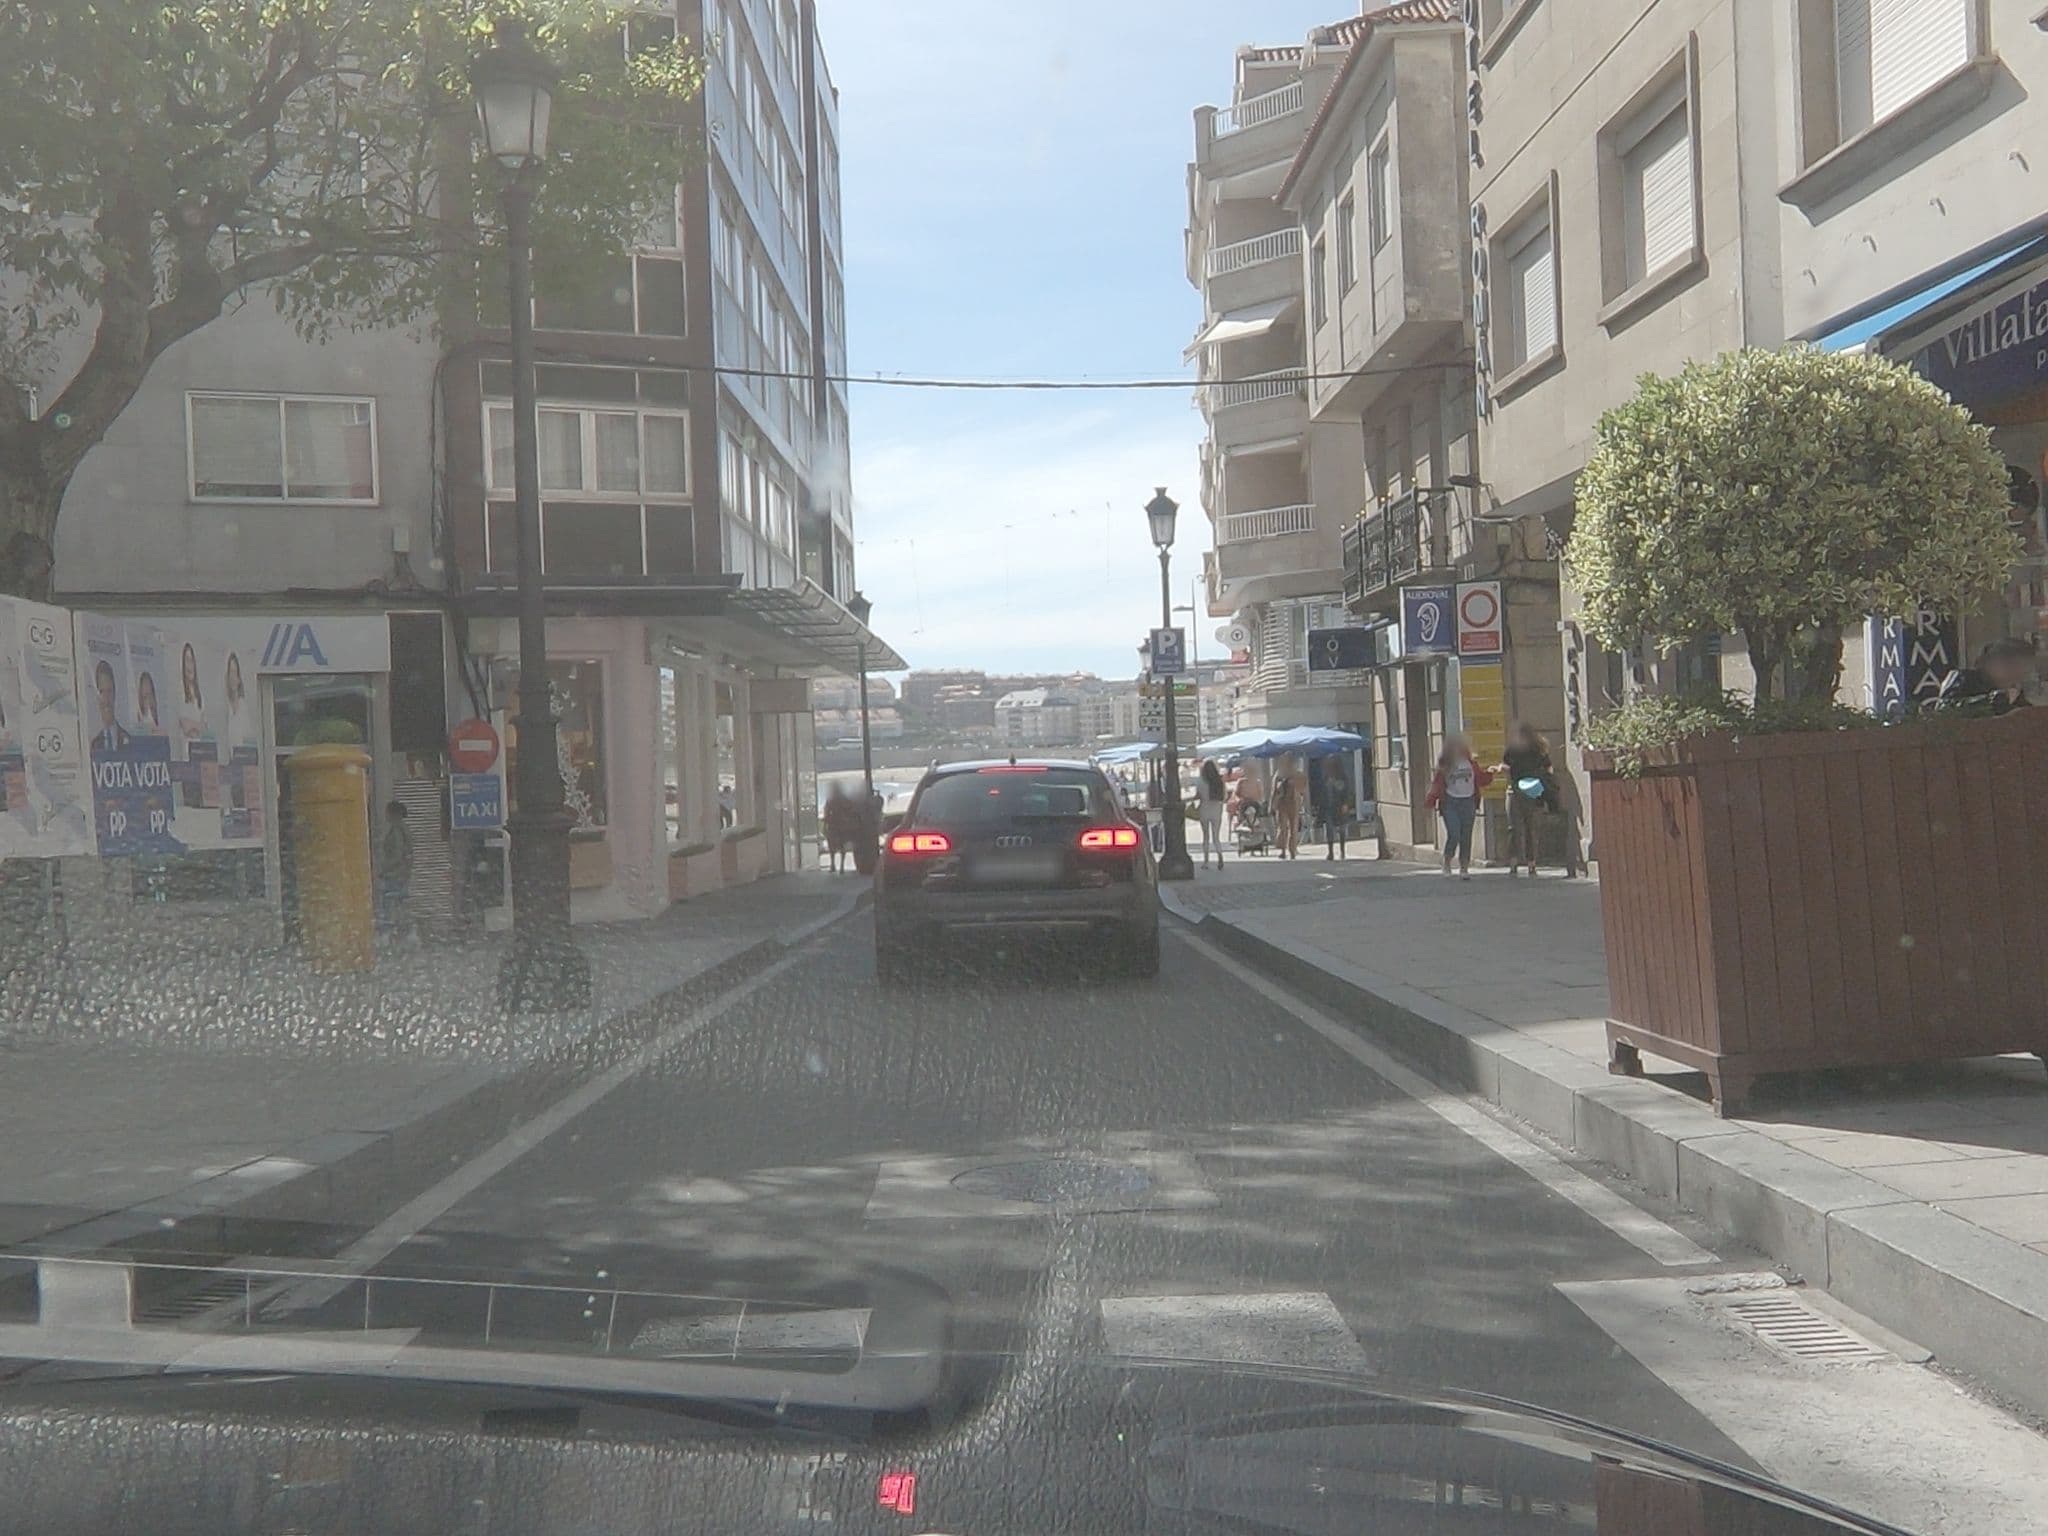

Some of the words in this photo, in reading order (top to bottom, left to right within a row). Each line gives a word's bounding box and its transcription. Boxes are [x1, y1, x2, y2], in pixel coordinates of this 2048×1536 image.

[93, 761, 132, 788] VOTA
[134, 761, 171, 788] VOTA
[455, 800, 497, 817] TAXI
